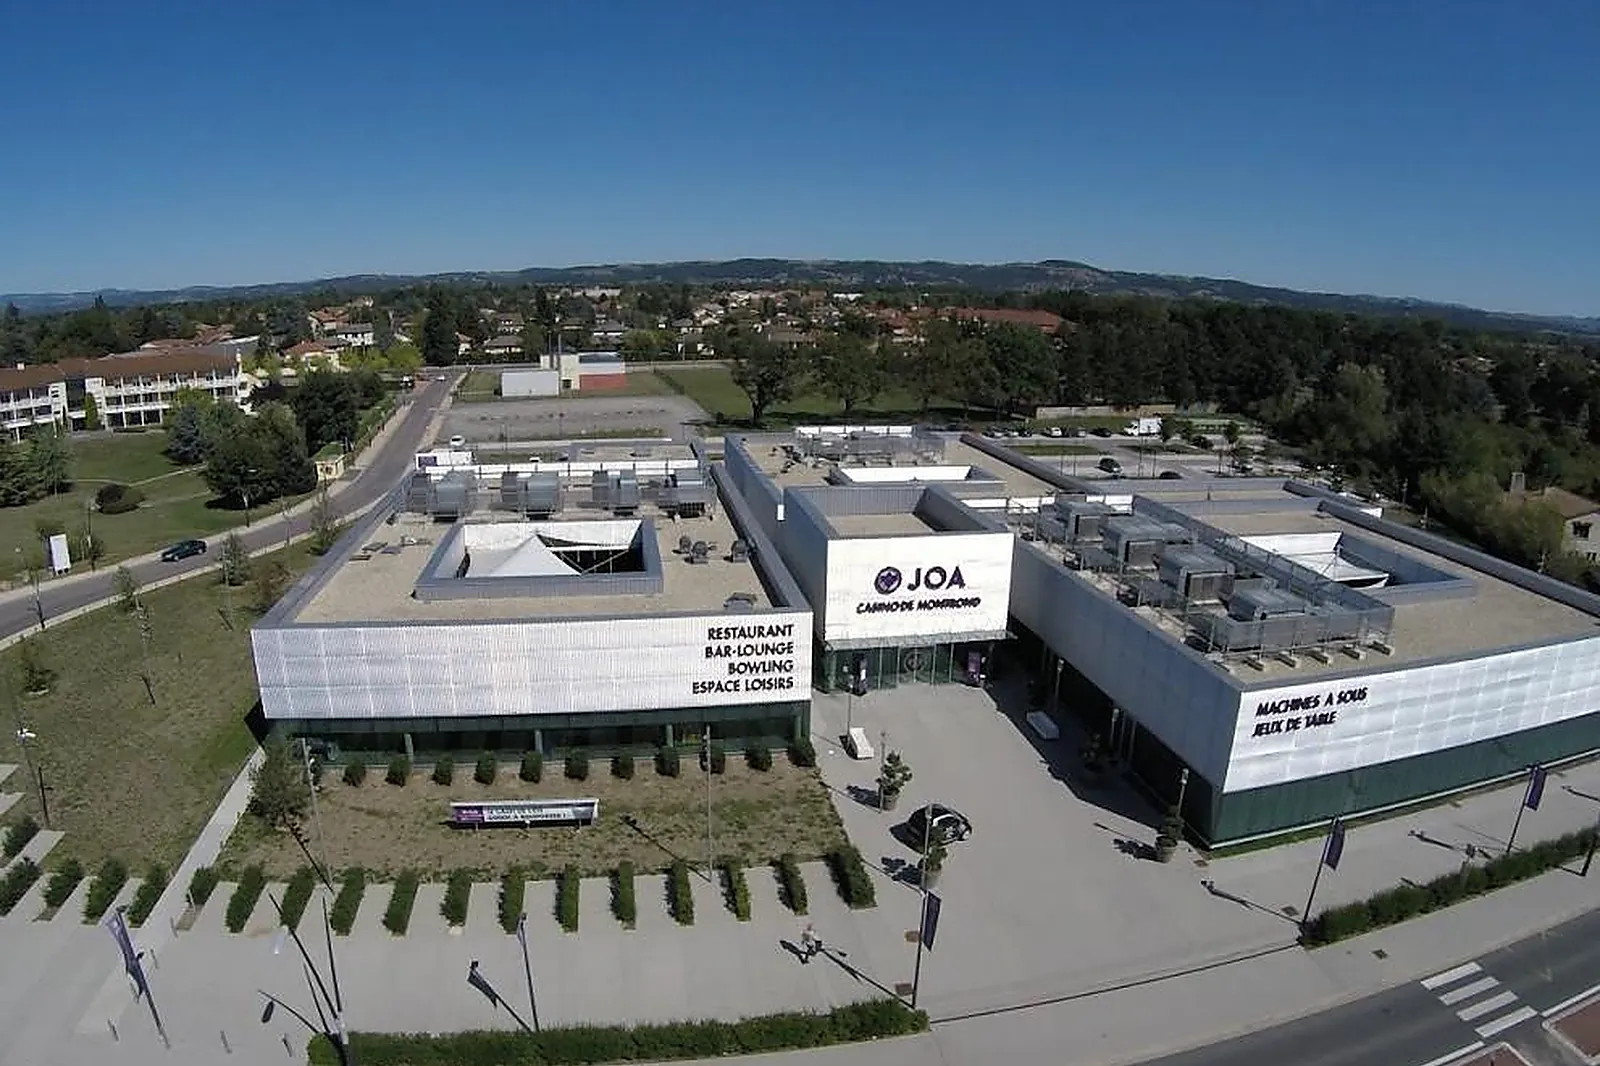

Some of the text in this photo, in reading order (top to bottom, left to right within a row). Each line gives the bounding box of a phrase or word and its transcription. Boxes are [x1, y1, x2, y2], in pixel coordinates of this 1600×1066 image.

[907, 565, 966, 591] JOA
[708, 624, 794, 640] RESTAURANT
[728, 659, 794, 675] BOWLING
[692, 676, 794, 694] ESPACE LOISIRS
[1256, 695, 1321, 717] MACHINES
[1336, 687, 1369, 705] SOUS
[1252, 719, 1285, 737] JEUX
[1285, 716, 1302, 732] DE
